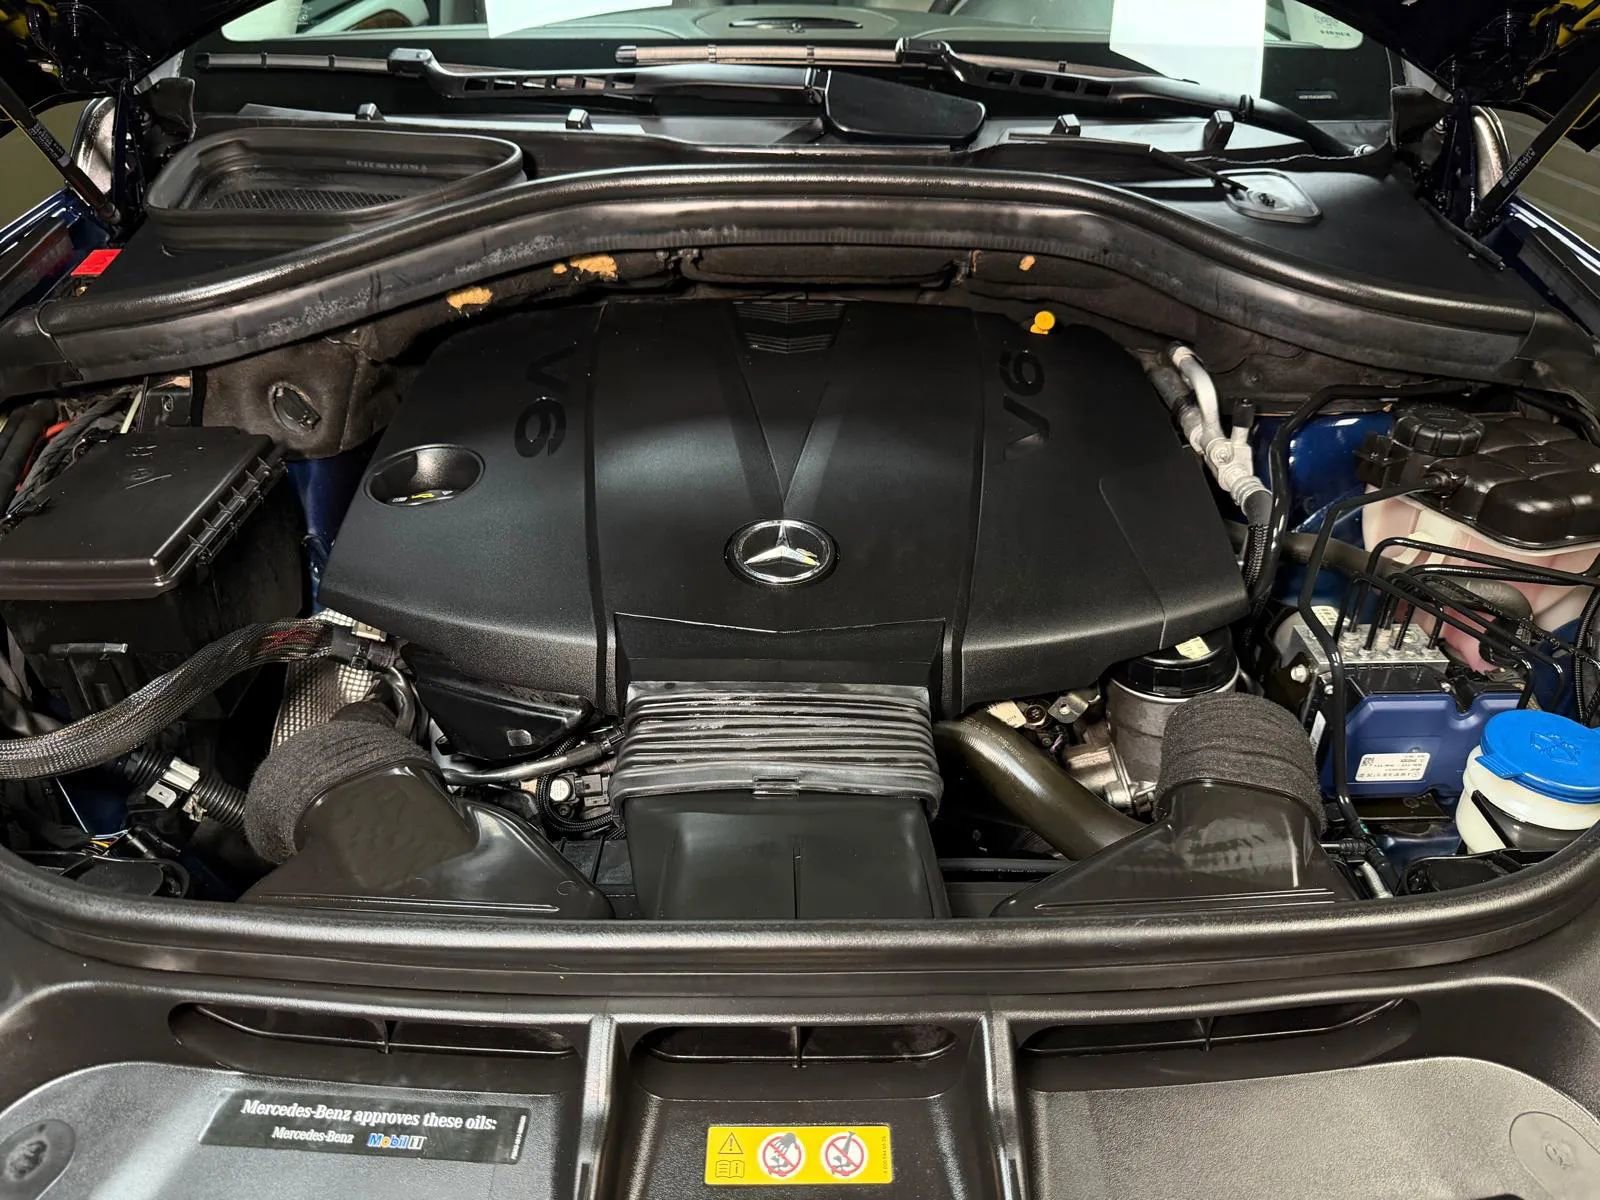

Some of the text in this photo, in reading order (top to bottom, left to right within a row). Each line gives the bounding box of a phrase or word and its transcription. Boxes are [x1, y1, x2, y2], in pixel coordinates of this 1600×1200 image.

[514, 345, 577, 458] V6
[998, 350, 1050, 461] V6
[241, 1099, 498, 1130] Mercedes-Benz approves these oils:
[271, 1127, 354, 1144] Mercedes-Benz
